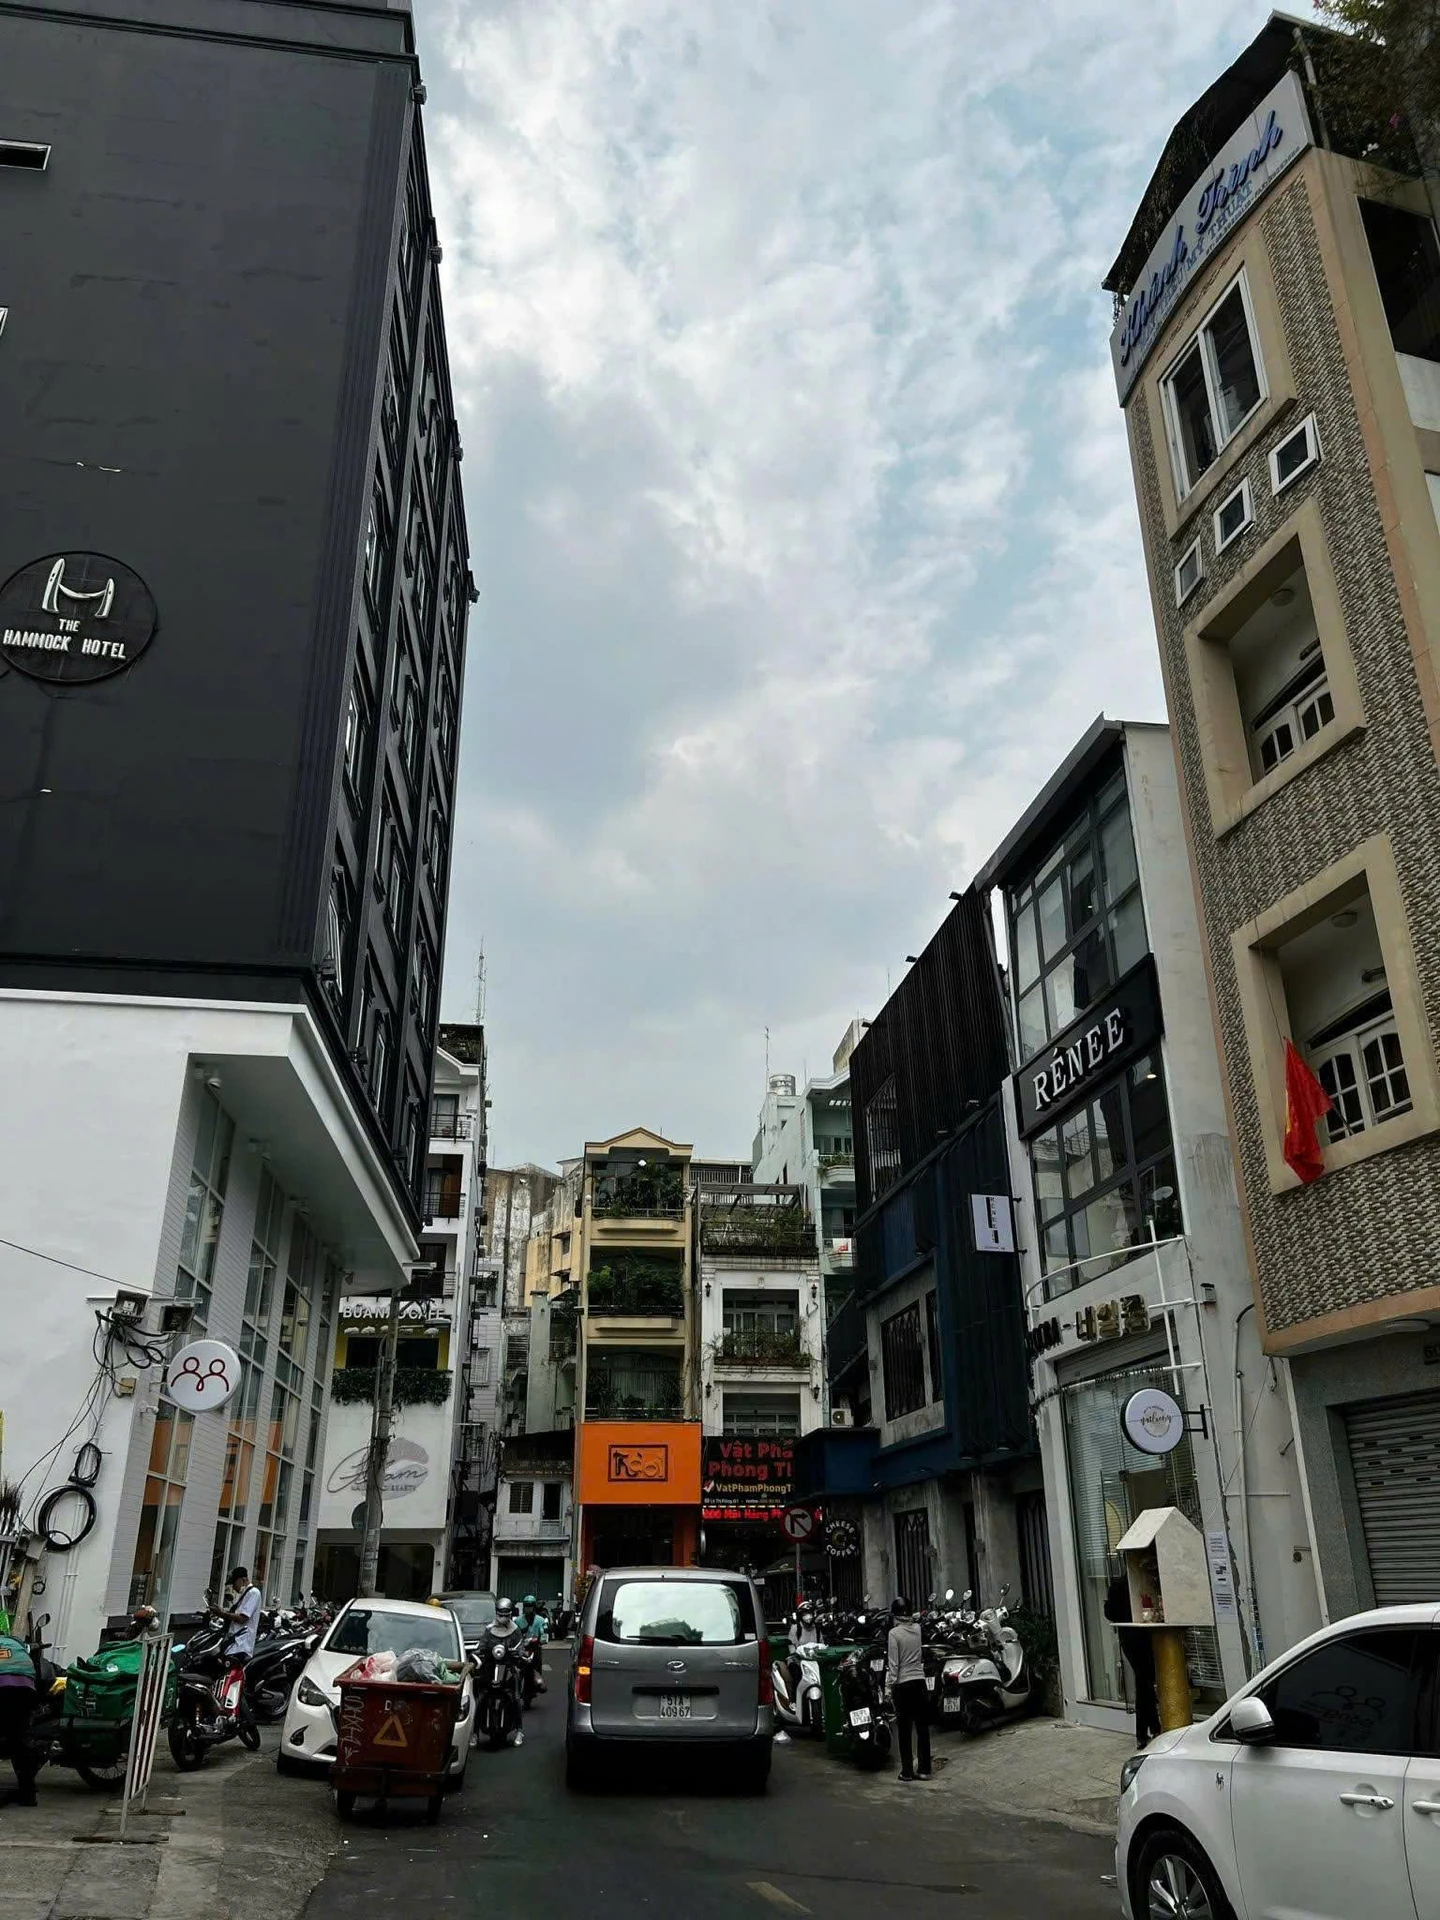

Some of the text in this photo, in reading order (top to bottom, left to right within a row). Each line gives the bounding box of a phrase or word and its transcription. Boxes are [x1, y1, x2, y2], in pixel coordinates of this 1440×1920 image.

[58, 618, 81, 632] THE
[2, 629, 127, 660] HAMMOCK HOTEL
[1031, 1007, 1127, 1113] RÉNEE
[716, 1483, 794, 1494] VatPhamPhongT
[826, 1544, 857, 1558] COFFEE
[667, 1696, 684, 1706] 51A
